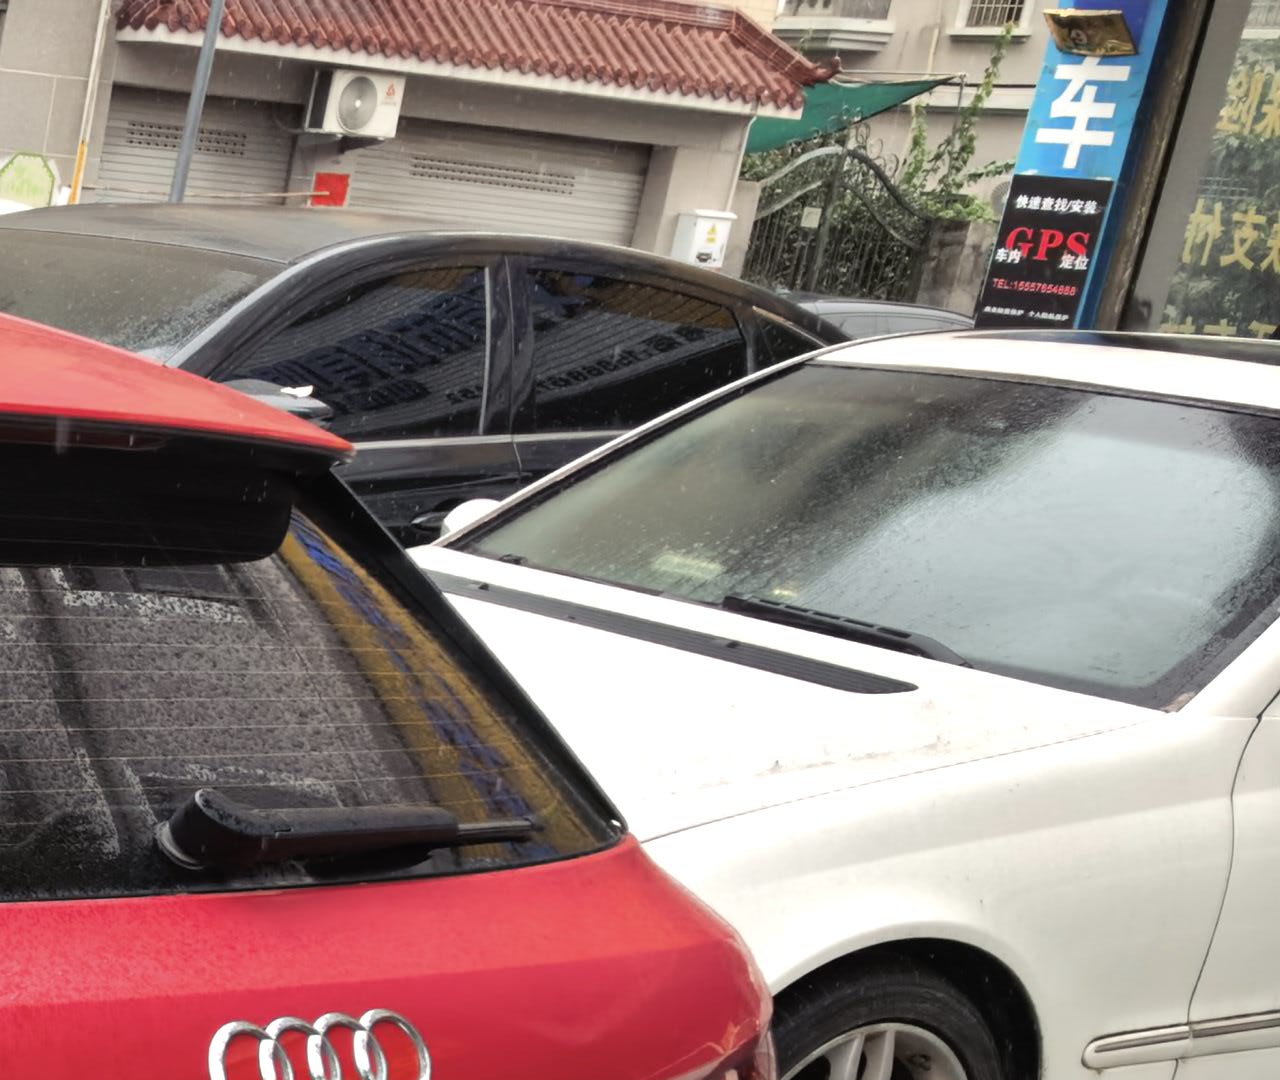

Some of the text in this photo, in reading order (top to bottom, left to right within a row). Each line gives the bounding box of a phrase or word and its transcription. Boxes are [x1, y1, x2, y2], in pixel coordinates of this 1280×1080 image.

[1035, 56, 1131, 169] 车
[1015, 194, 1097, 214] 快速查找/安装
[1005, 227, 1091, 261] GPS
[995, 248, 1090, 270] 车内 定位
